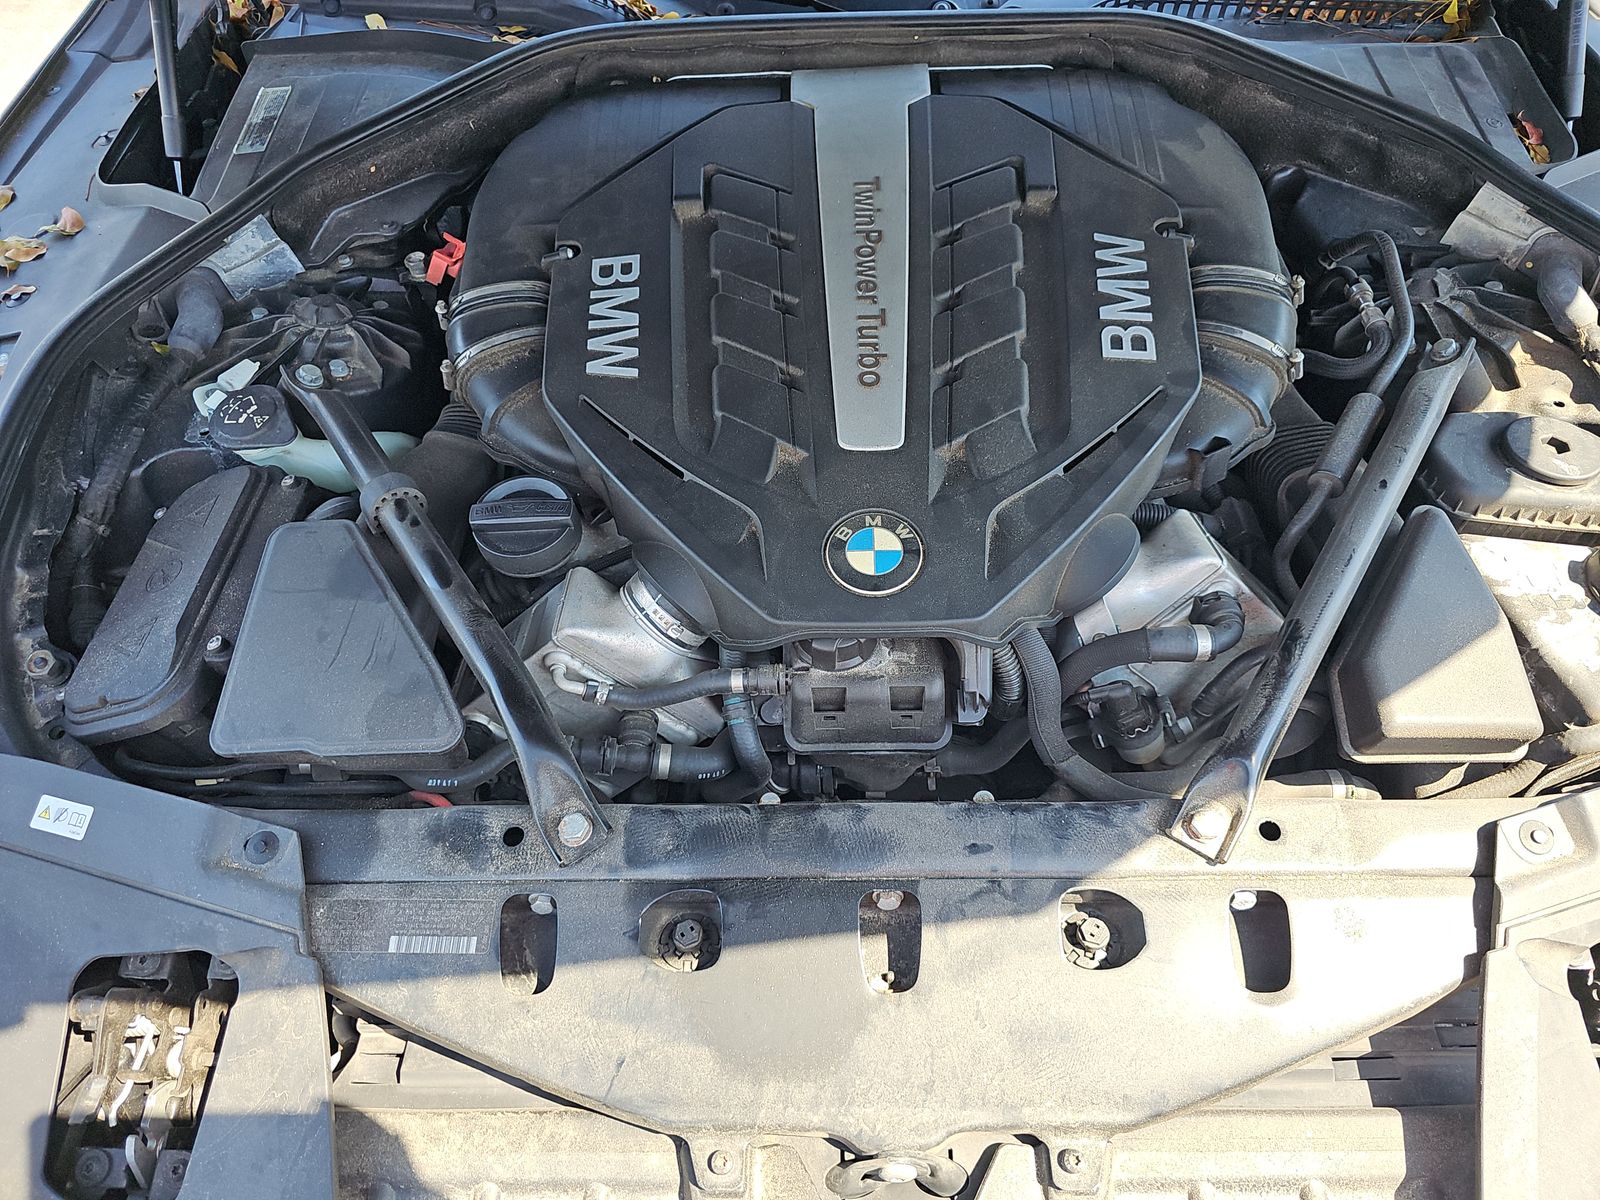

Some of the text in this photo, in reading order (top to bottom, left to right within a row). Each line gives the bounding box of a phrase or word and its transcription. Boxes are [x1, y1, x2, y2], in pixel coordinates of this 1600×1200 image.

[586, 254, 640, 377] BMW
[853, 176, 887, 388] TwinPower Turbo
[1094, 232, 1157, 360] BMW
[835, 515, 914, 542] BMW
